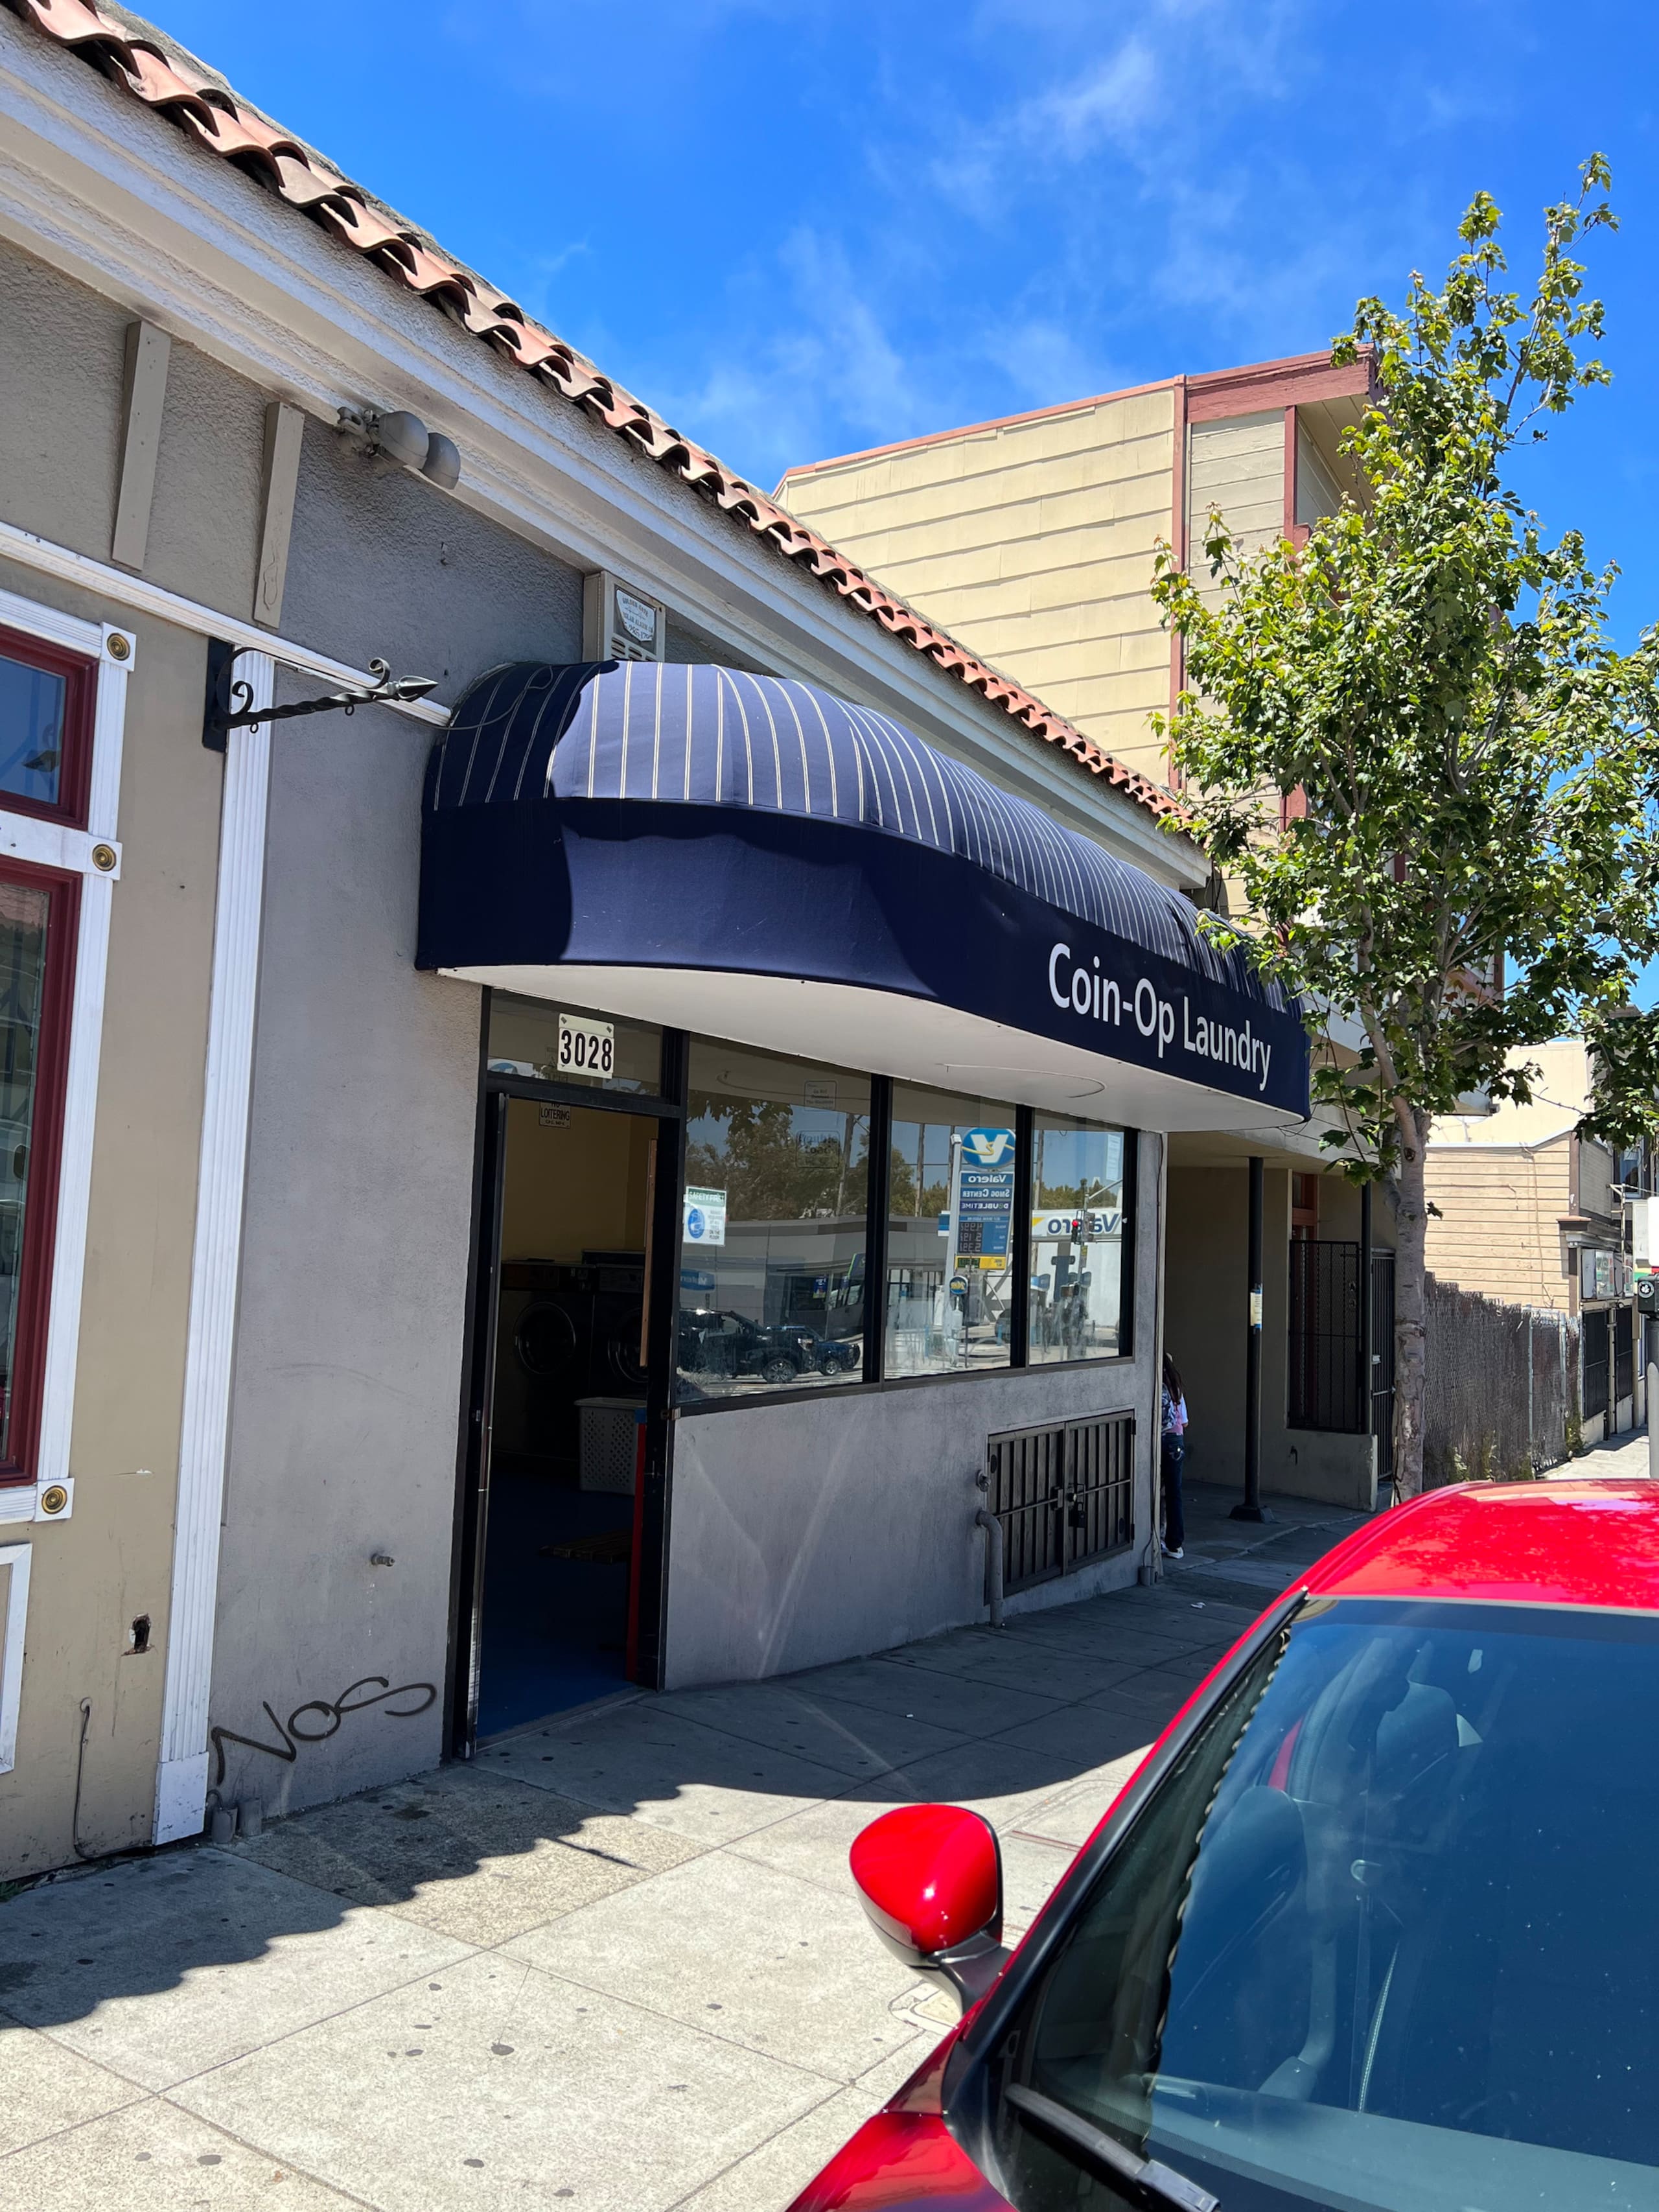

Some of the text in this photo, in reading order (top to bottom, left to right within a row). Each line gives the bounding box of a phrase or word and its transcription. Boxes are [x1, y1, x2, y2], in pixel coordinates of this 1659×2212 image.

[1049, 942, 1271, 1092] Coin-Op Laundry
[561, 1029, 612, 1072] 3028
[541, 1108, 570, 1121] LOITERING
